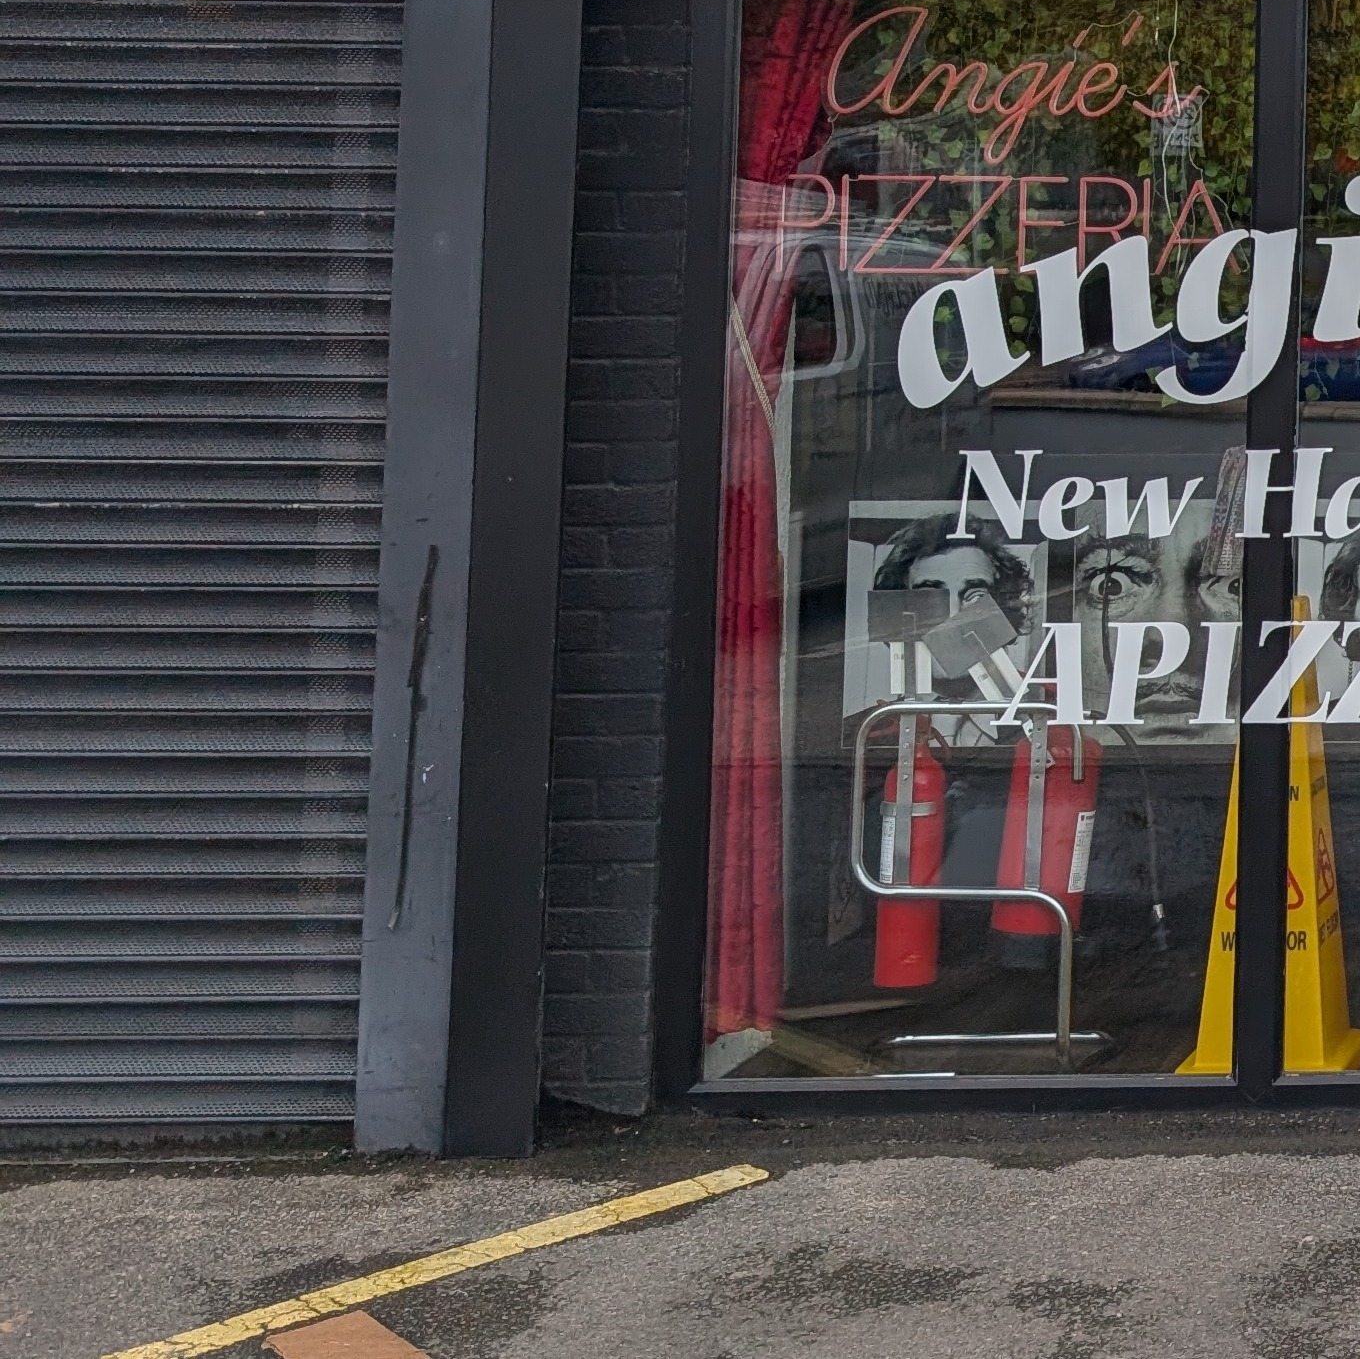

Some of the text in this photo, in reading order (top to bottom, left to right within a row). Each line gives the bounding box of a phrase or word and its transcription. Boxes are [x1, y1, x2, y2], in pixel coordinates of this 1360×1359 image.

[826, 6, 1203, 165] Angie's
[775, 174, 1242, 275] PIZZERIA
[947, 449, 1204, 540] New
